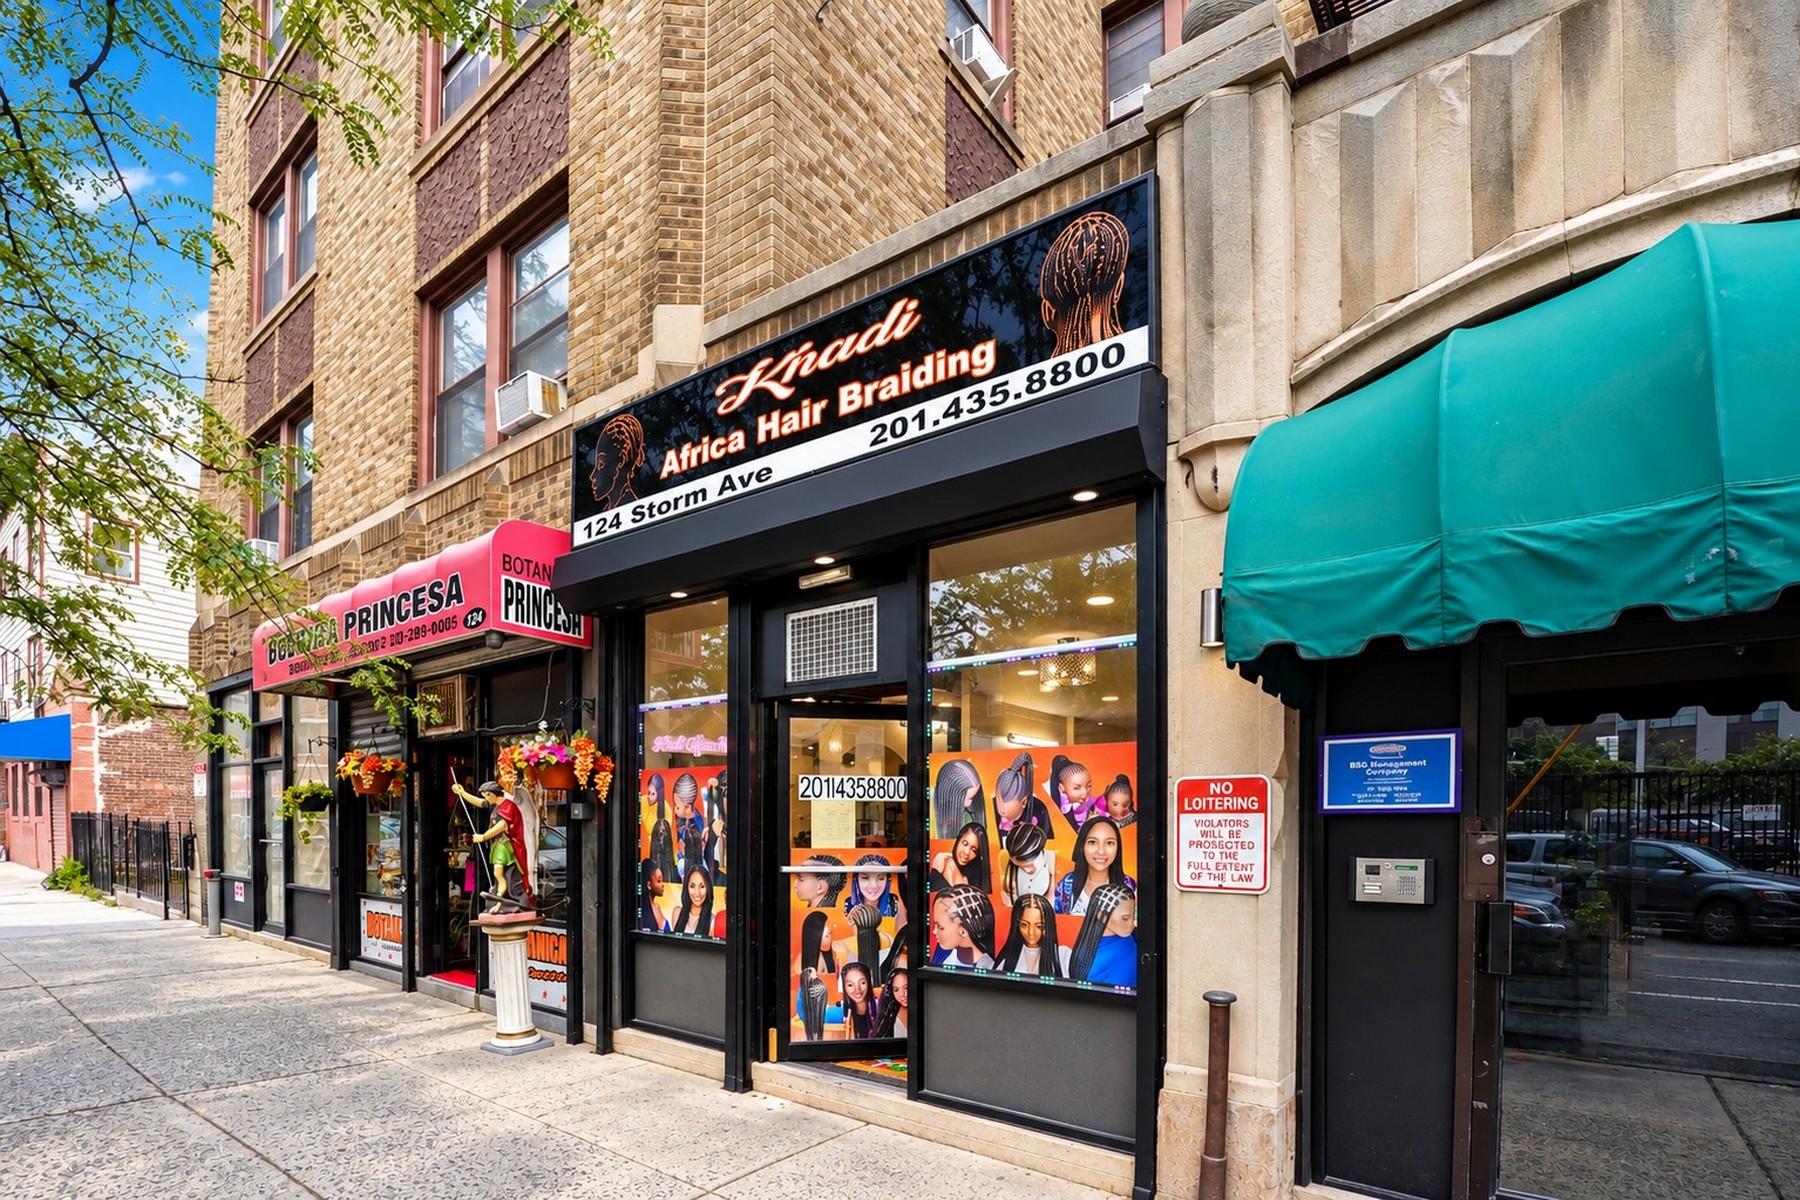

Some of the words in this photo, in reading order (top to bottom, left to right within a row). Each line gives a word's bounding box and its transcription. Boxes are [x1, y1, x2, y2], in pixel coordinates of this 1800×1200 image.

[869, 342, 1126, 447] 201.435.8800
[659, 429, 746, 480] Africa
[757, 397, 829, 444] Hair
[838, 338, 998, 418] Braiding
[583, 512, 622, 539] 124
[631, 487, 708, 524] Storm
[717, 466, 773, 496] Ave
[343, 572, 464, 640] PRINCESA
[1209, 782, 1233, 795] NO
[1184, 797, 1259, 811] LOITERING
[1195, 819, 1250, 828] VIOLATORS
[1200, 830, 1224, 839] WILL
[1228, 830, 1242, 839] BE
[1203, 851, 1215, 860] TO
[1219, 851, 1238, 861] THE
[1187, 861, 1211, 871] FULL
[1215, 862, 1255, 872] EXTENT
[1190, 872, 1203, 881] OF
[1207, 872, 1227, 882] THE
[1231, 874, 1254, 883] LAW
